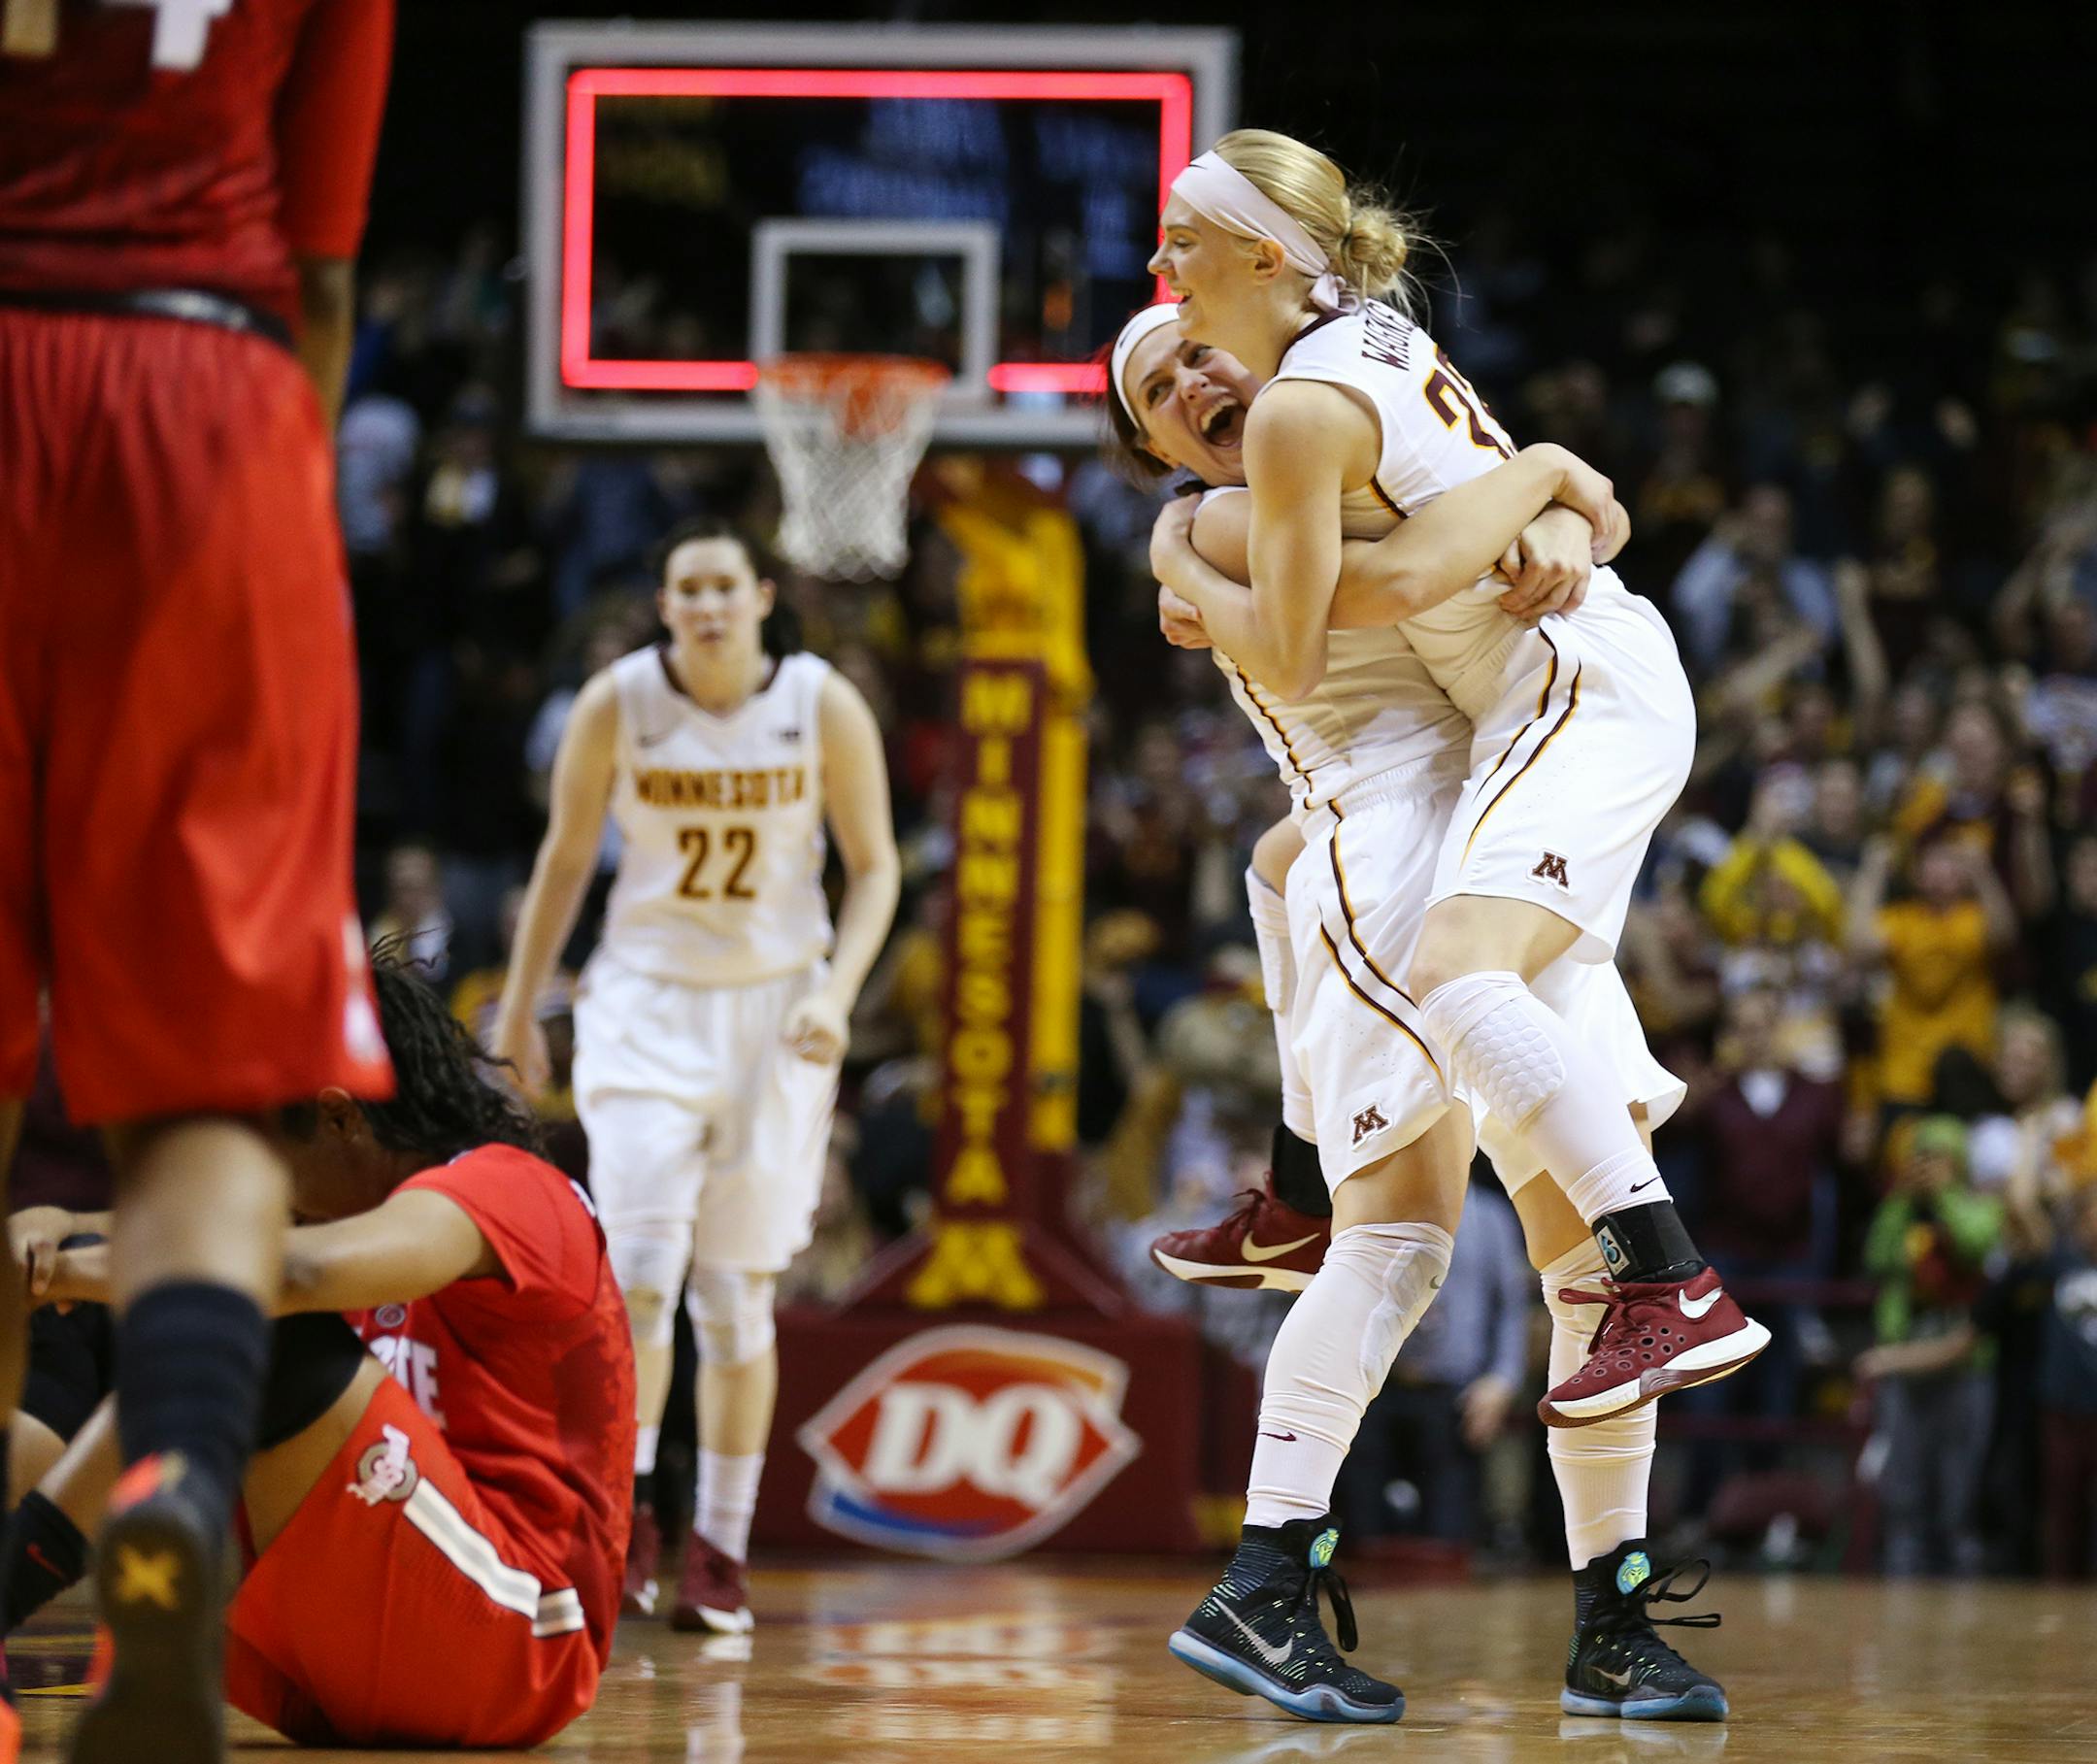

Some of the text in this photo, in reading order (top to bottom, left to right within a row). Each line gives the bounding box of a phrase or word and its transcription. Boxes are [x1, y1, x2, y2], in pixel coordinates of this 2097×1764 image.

[635, 767, 806, 810] MINNESOTA
[677, 827, 757, 898] 22
[1531, 851, 1570, 890] M
[947, 670, 1033, 1206] MINNESOTA
[1351, 1105, 1389, 1146] M
[867, 1381, 1080, 1509] DQ
